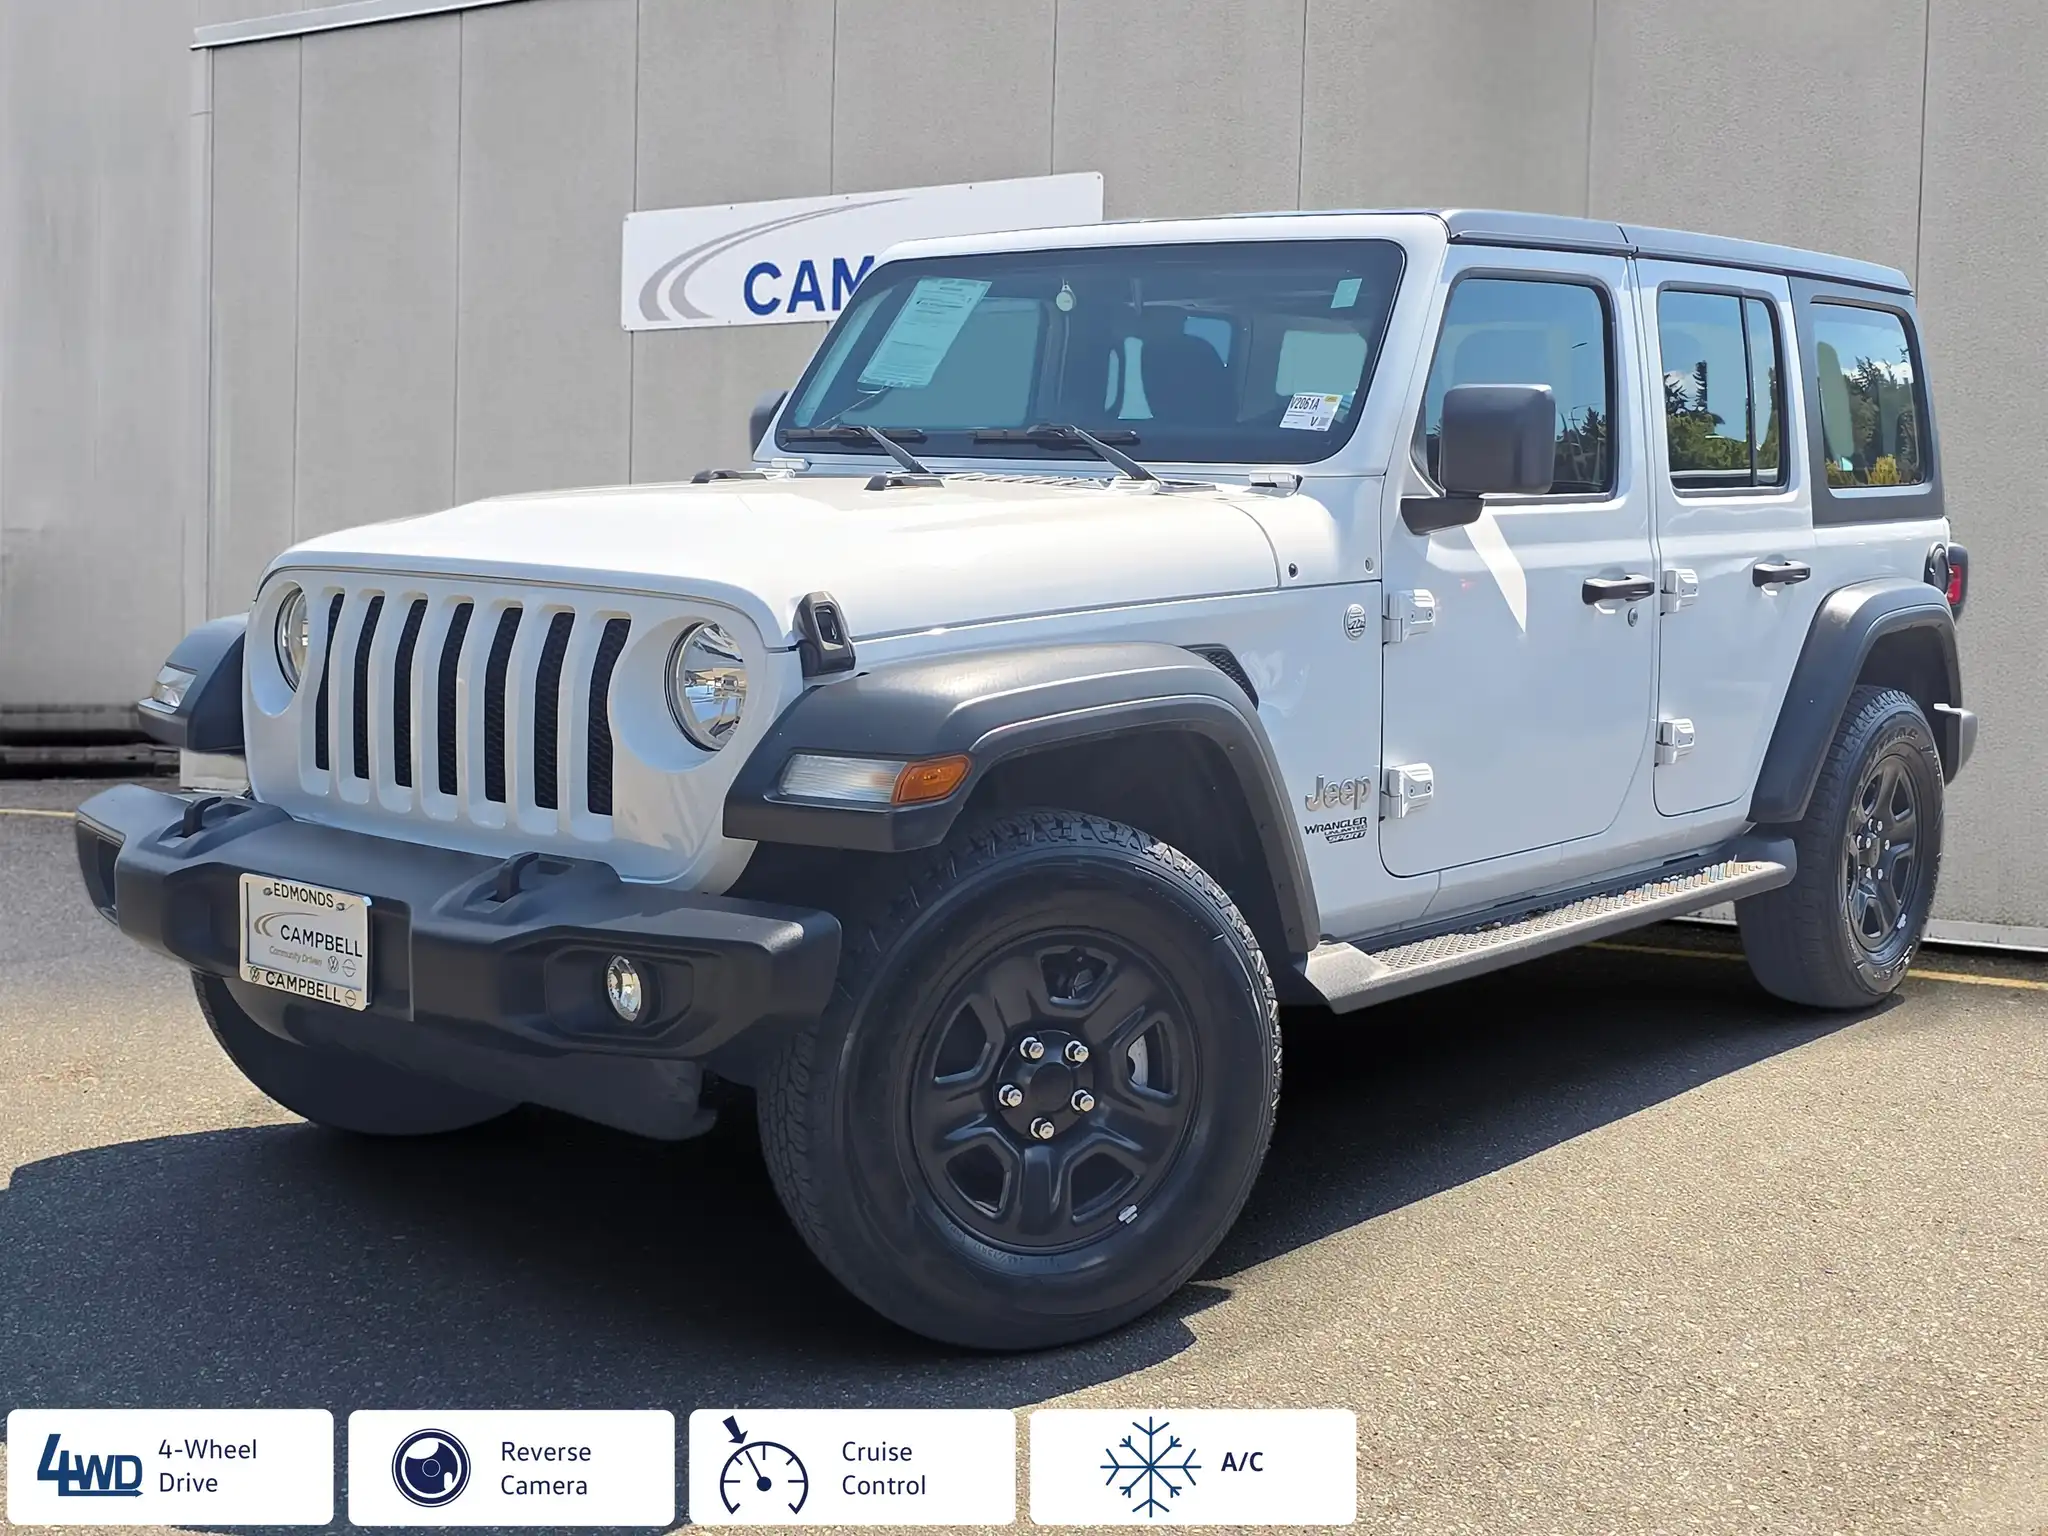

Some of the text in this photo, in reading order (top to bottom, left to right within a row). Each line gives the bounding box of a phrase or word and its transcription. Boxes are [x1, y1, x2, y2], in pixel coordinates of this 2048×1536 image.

[1305, 774, 1371, 811] Jeep
[1304, 816, 1367, 835] WRANGLER
[273, 882, 334, 908] EDMONDS
[280, 924, 363, 958] CAMPBELL
[265, 971, 341, 1003] CAMPBELL
